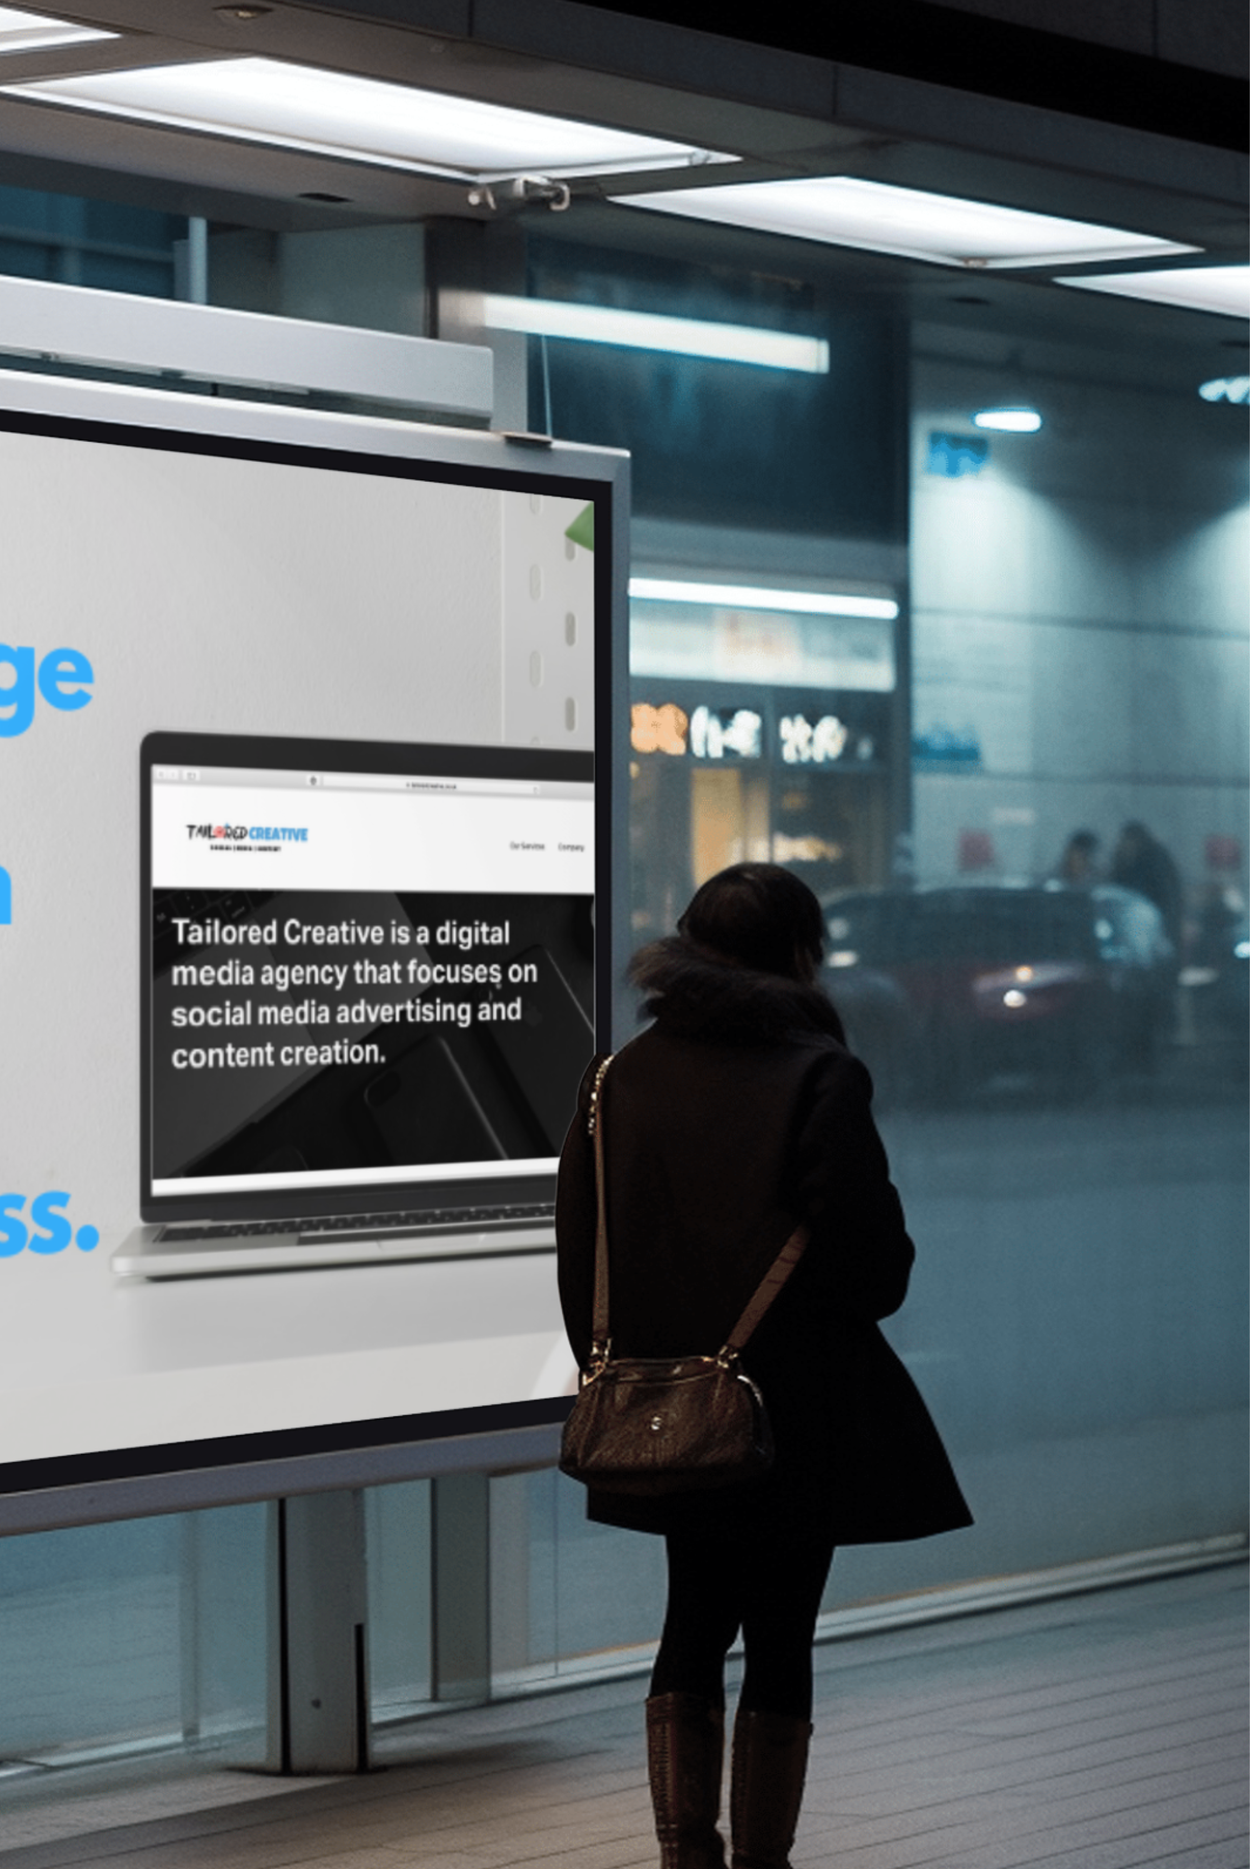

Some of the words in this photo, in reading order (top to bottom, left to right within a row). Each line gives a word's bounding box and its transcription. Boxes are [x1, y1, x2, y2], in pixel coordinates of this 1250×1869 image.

[186, 822, 248, 841] TAILORED
[249, 826, 308, 842] CREATIVE
[171, 918, 277, 945] Tailored
[284, 918, 385, 945] Creative
[390, 919, 411, 945] is
[416, 925, 430, 945] a
[436, 920, 510, 951] digital
[172, 959, 255, 986] media
[260, 964, 348, 992] agency
[353, 958, 402, 985] that
[407, 958, 502, 984] focuses
[508, 963, 537, 983] on
[171, 1000, 252, 1027] social
[257, 999, 330, 1025] media
[335, 997, 471, 1028] advertising
[477, 996, 522, 1021] and
[171, 1042, 275, 1069] content
[279, 1039, 386, 1066] creation.
